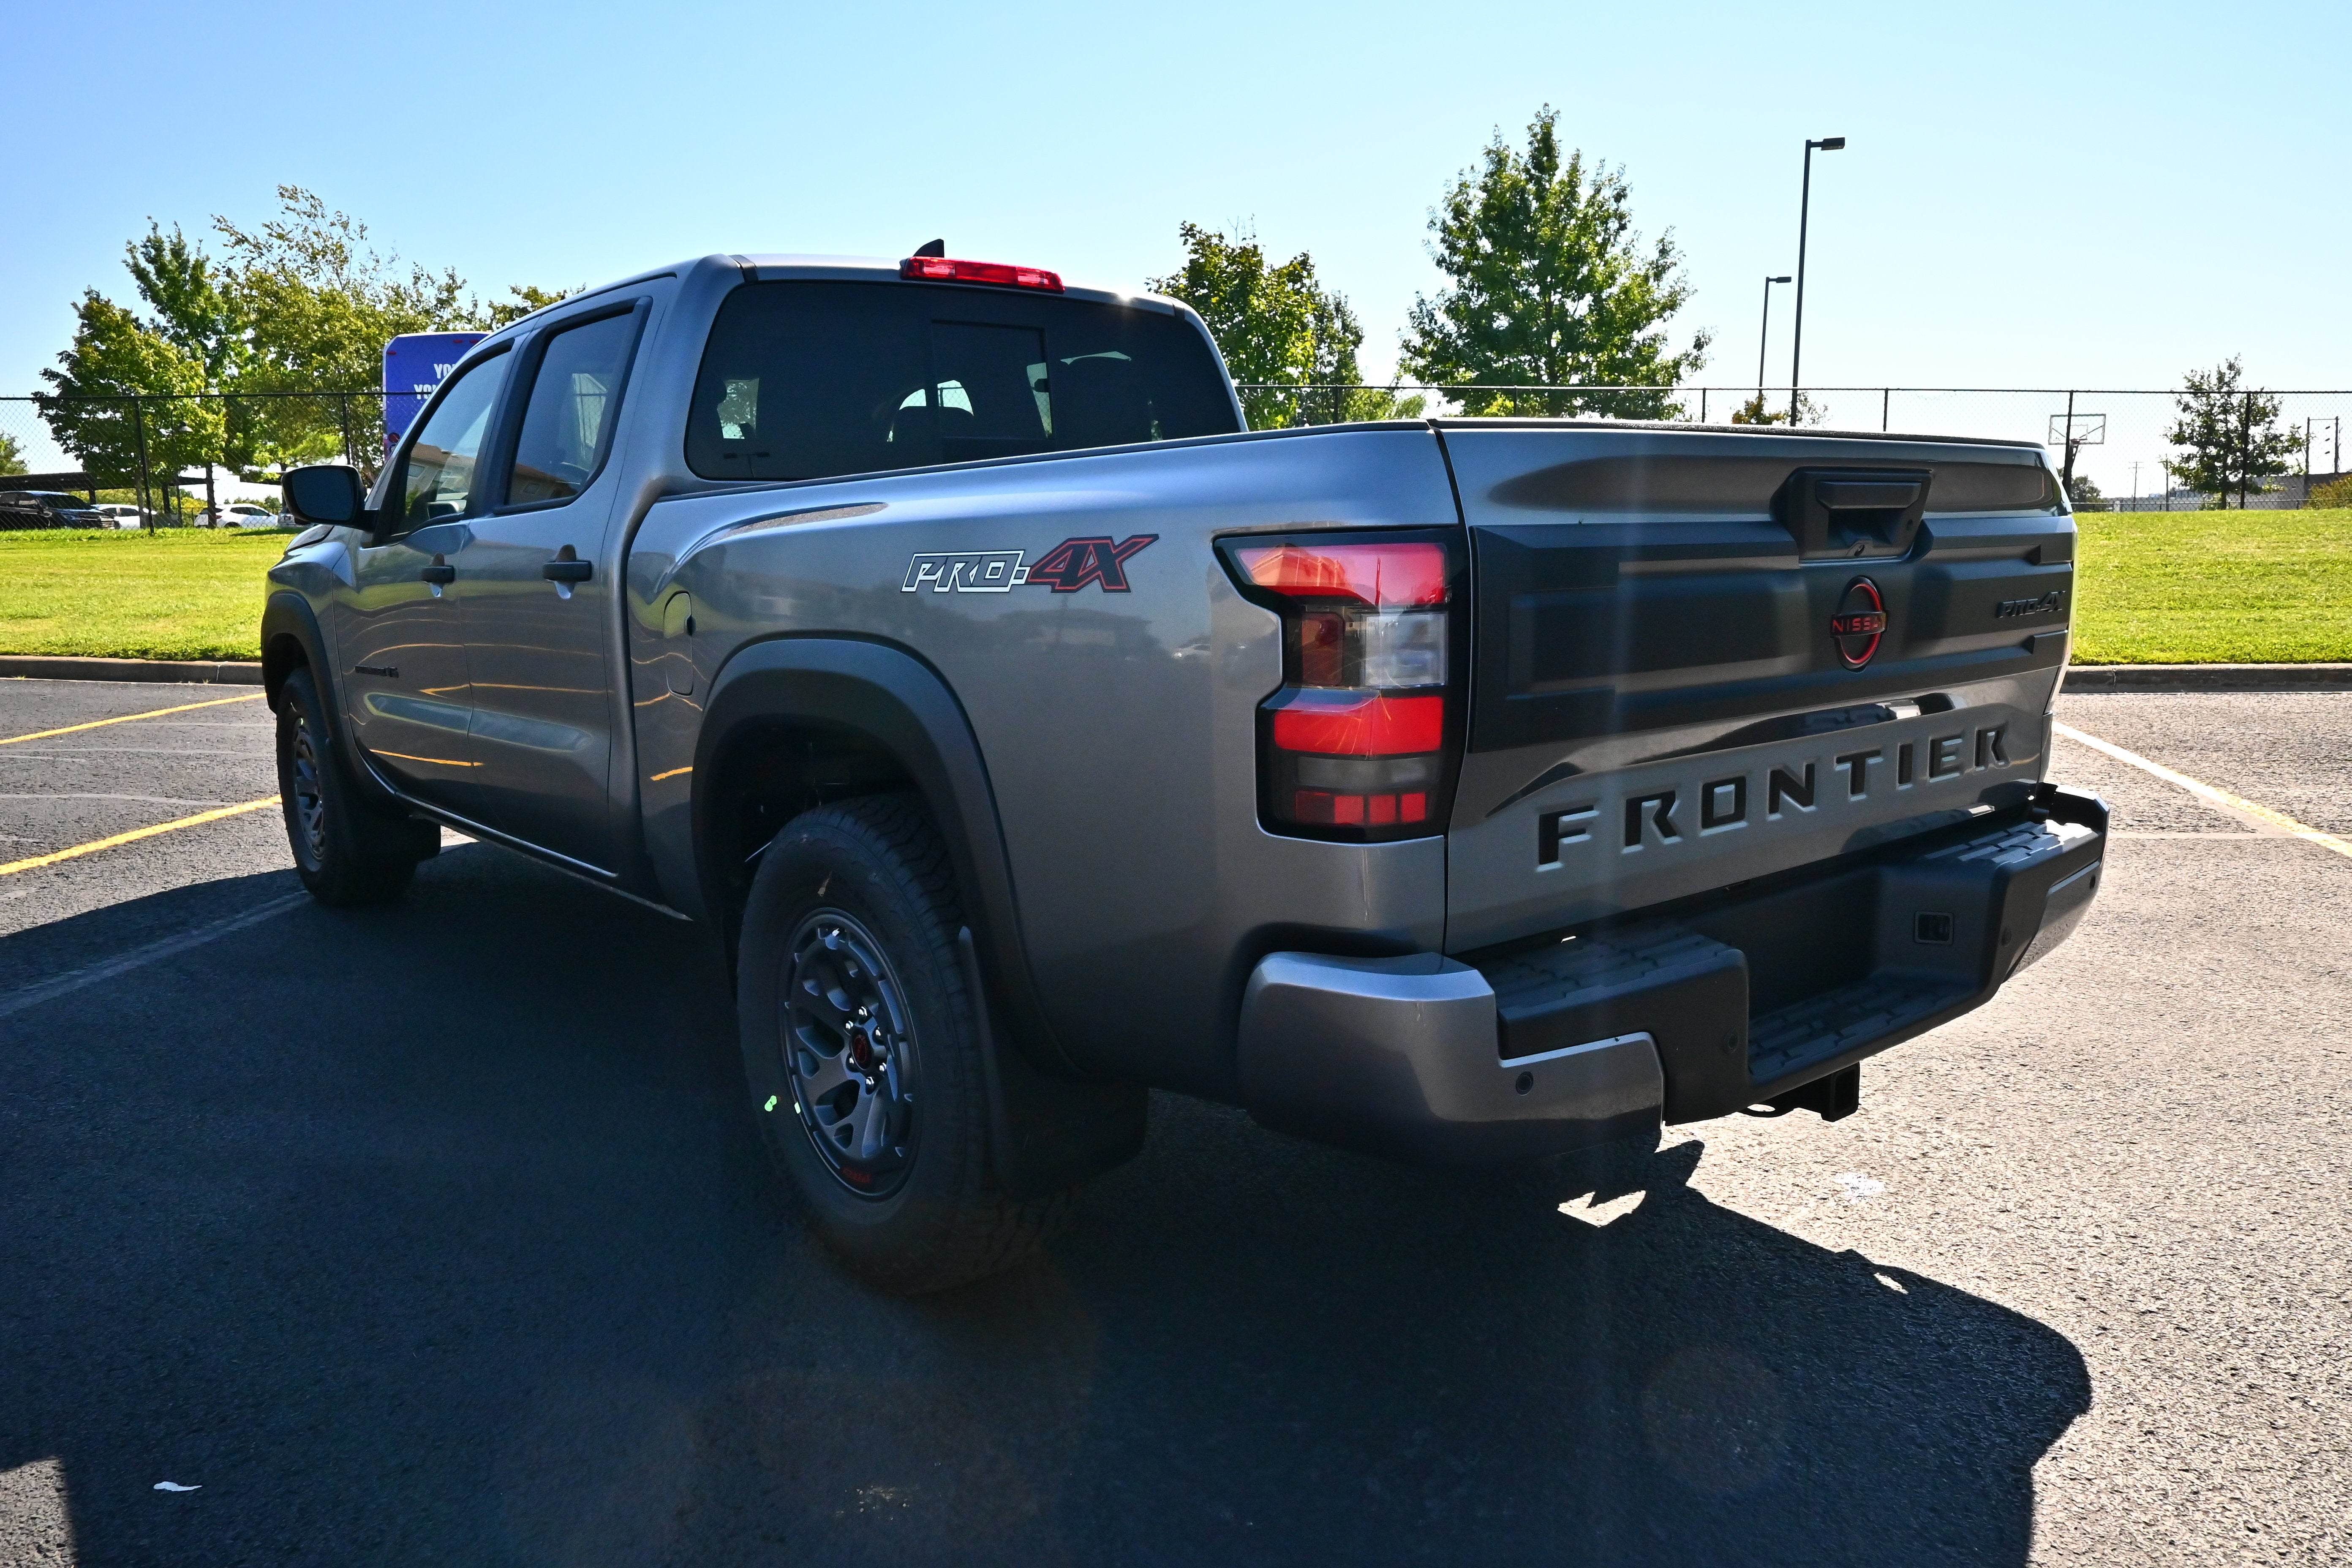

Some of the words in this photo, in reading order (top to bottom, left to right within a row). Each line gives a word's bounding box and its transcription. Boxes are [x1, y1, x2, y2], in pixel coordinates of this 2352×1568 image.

[434, 364, 456, 379] YO
[901, 534, 1159, 593] PRO-4X
[1535, 724, 2012, 871] FRONTIER
